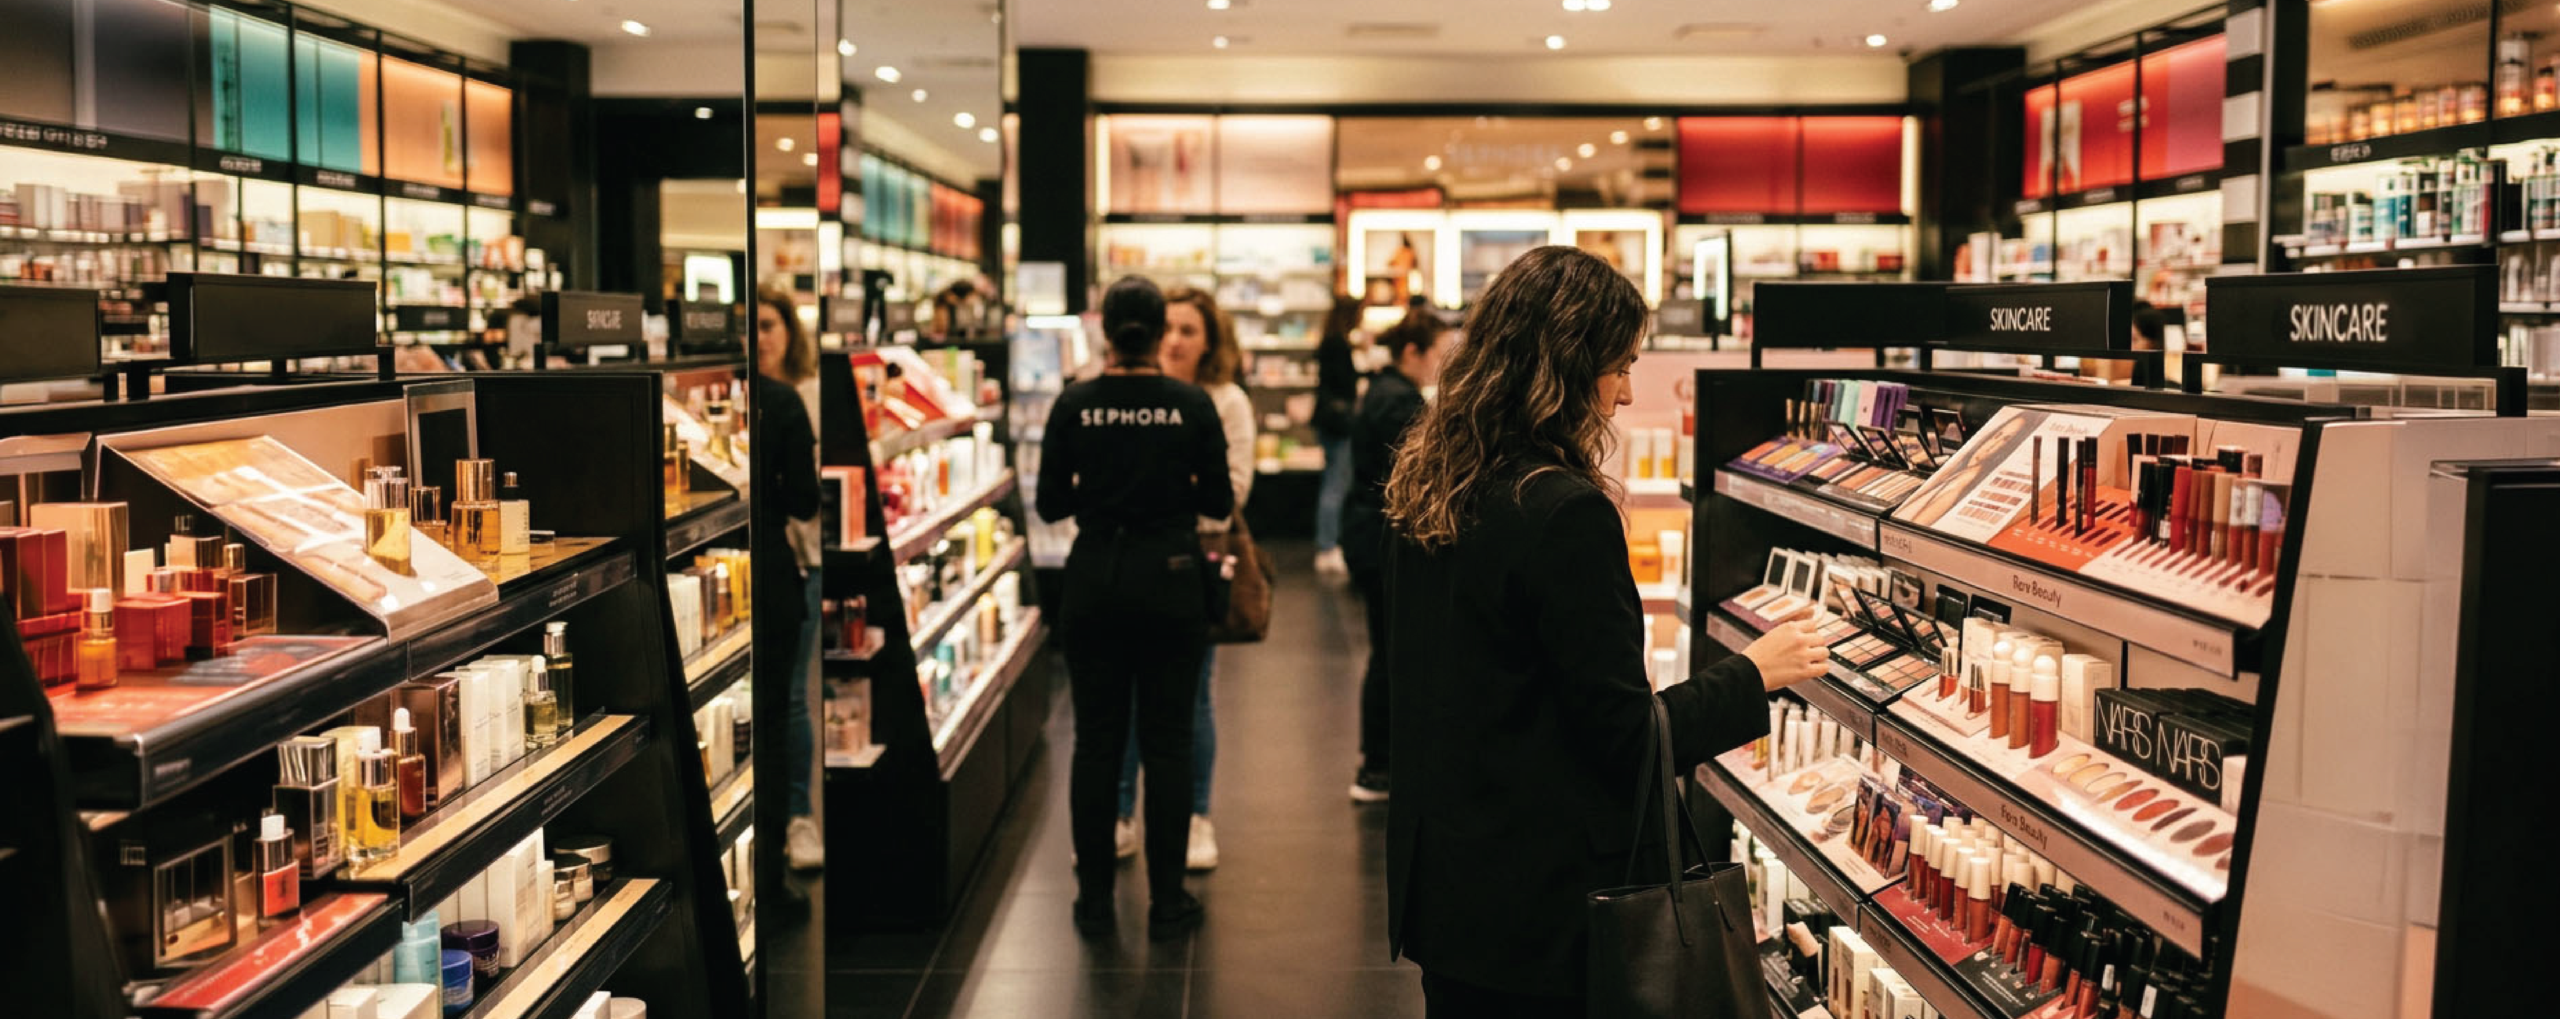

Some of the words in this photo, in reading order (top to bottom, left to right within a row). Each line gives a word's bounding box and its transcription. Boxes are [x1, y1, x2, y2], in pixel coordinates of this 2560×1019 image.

[1989, 307, 2052, 332] SKINCARE
[2289, 303, 2389, 343] SKINCARE
[1080, 407, 1184, 427] SEPHORA
[2095, 695, 2152, 760] NARS
[2156, 721, 2221, 790] NARS
